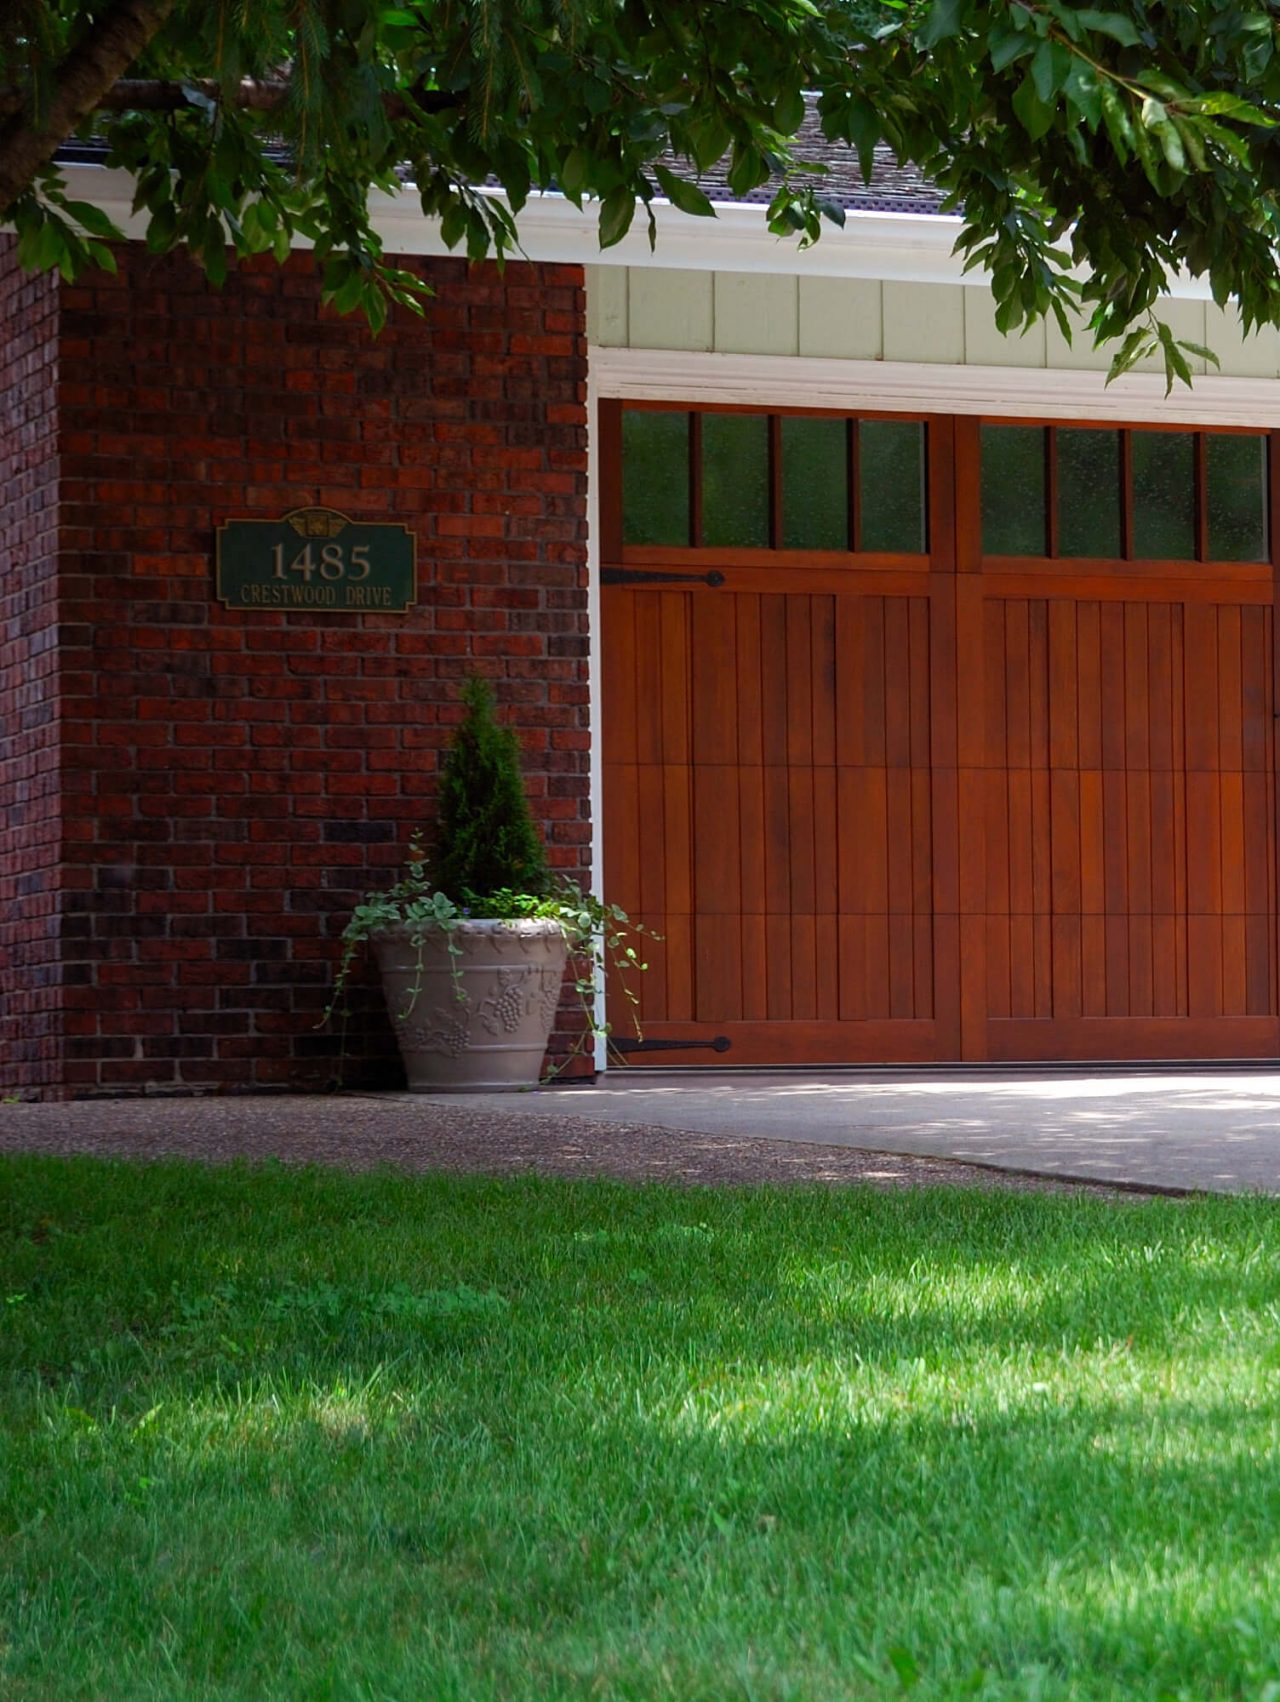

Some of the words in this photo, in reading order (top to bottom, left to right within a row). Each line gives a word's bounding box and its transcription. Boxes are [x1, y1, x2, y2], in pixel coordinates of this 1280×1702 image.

[271, 543, 370, 581] 1485
[240, 585, 336, 605] CRESTWOOD
[346, 586, 391, 606] DRIVE
